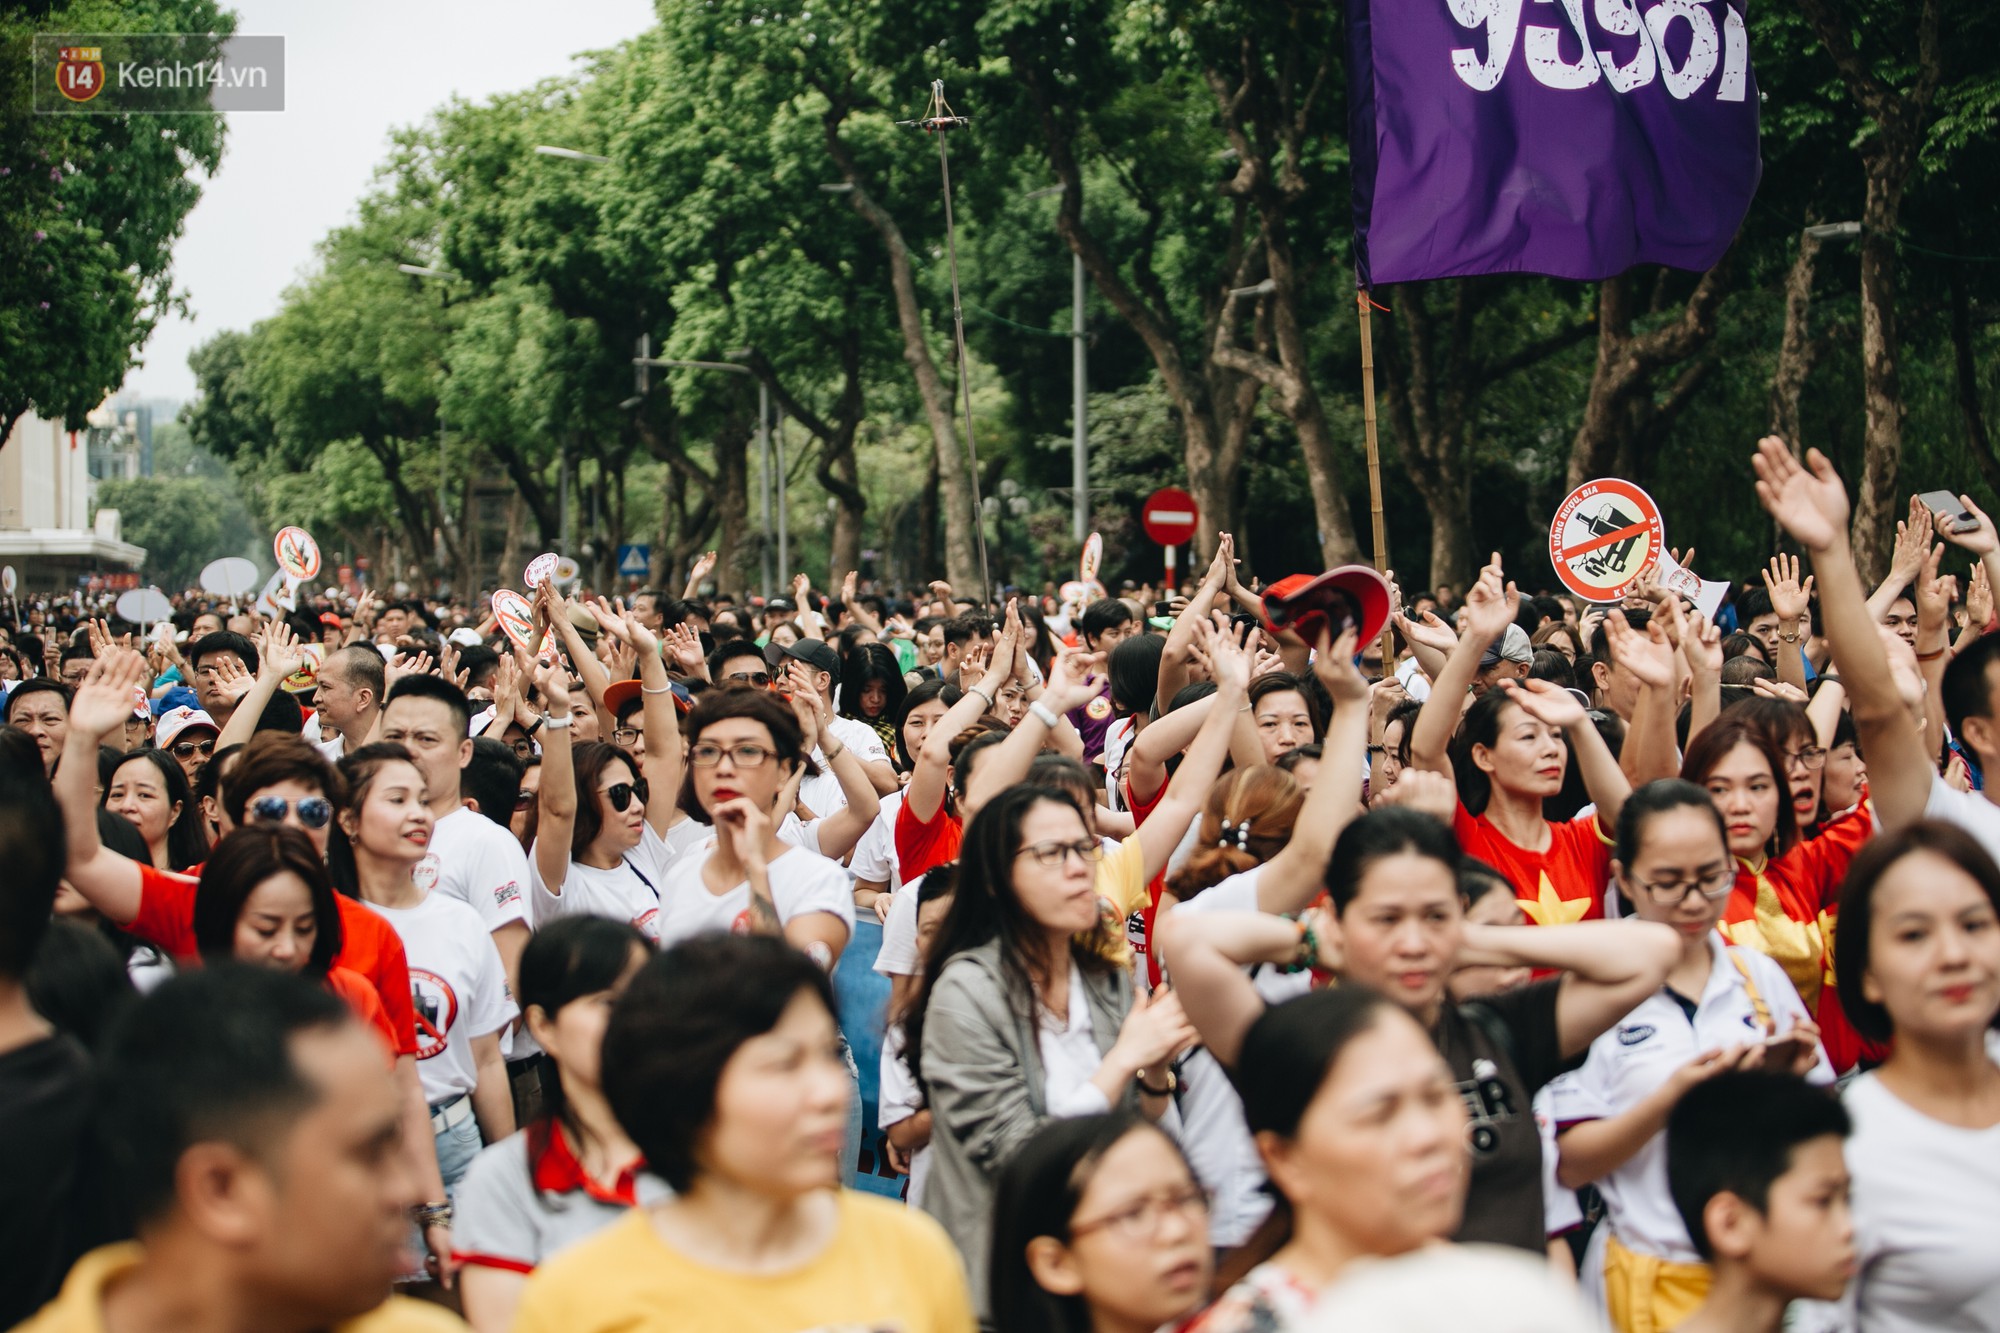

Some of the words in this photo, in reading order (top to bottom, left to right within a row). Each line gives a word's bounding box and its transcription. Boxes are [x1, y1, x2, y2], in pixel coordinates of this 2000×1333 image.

[1551, 519, 1565, 546] UỐNG
[1581, 485, 1599, 498] BIA
[1649, 516, 1660, 534] XE
